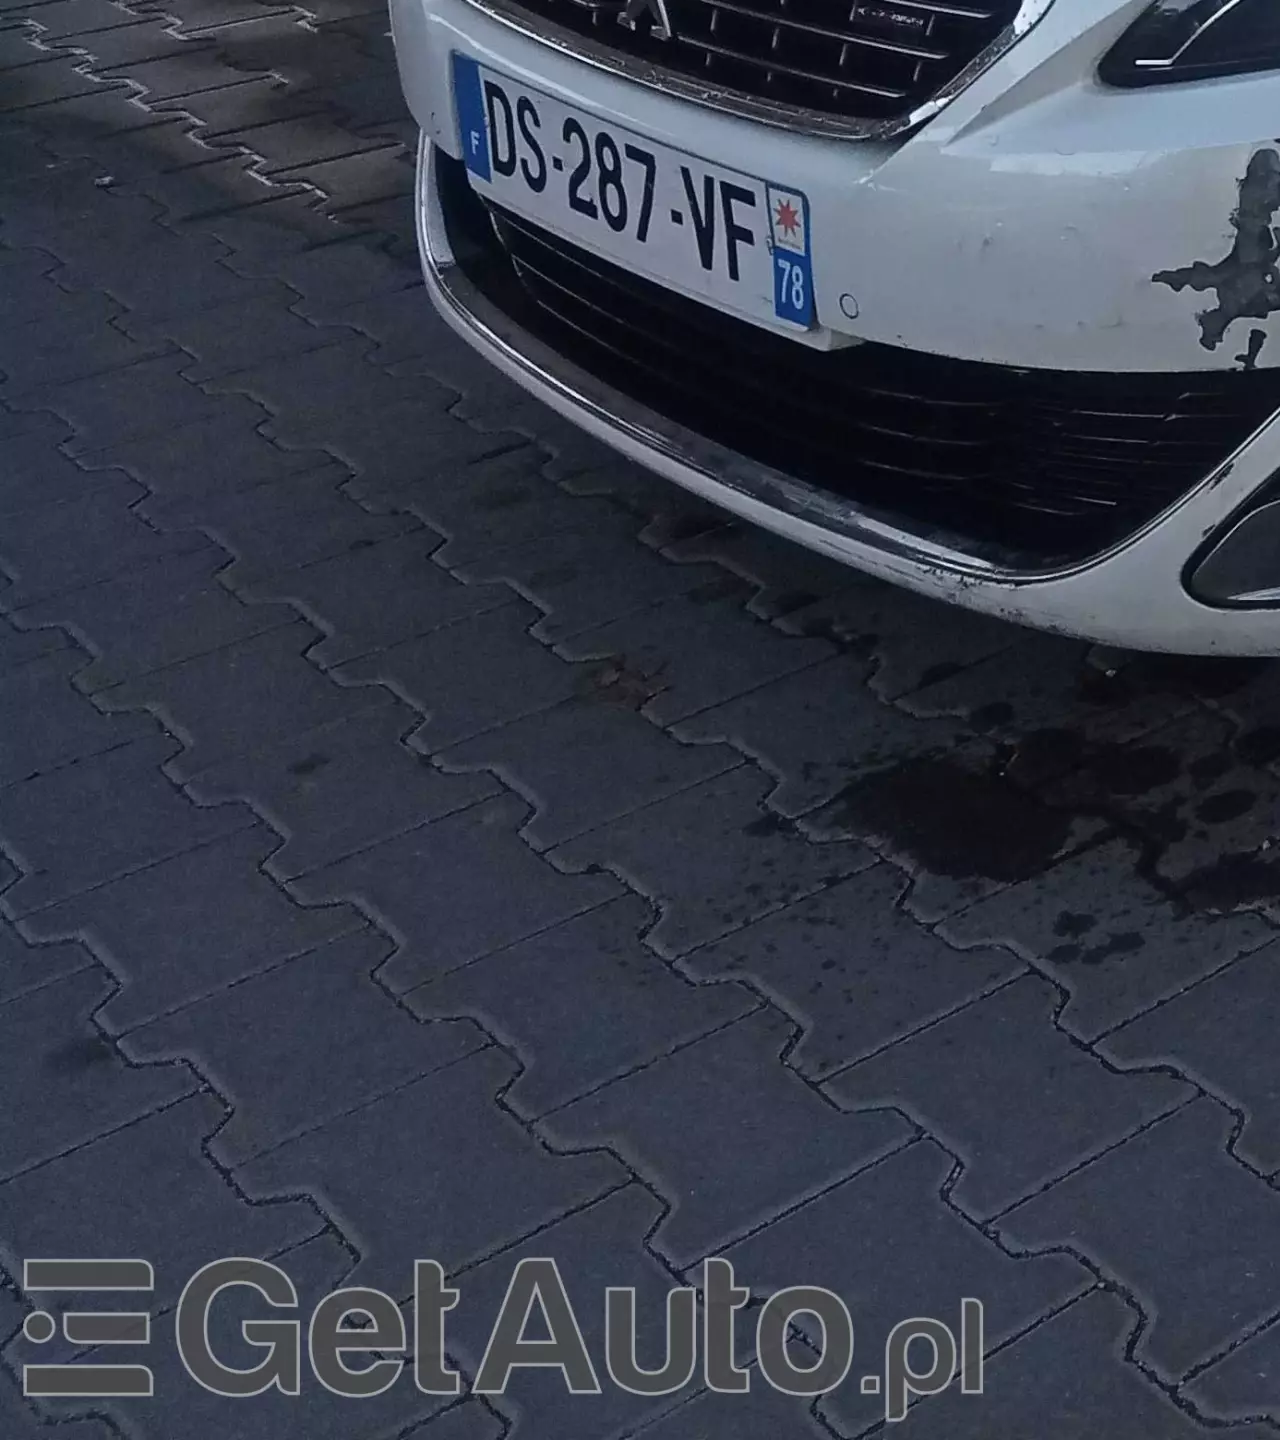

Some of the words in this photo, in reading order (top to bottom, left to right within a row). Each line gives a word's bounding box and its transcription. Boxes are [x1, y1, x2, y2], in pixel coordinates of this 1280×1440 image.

[469, 130, 481, 156] F
[482, 78, 757, 283] DS-287-VF
[777, 258, 805, 311] 78
